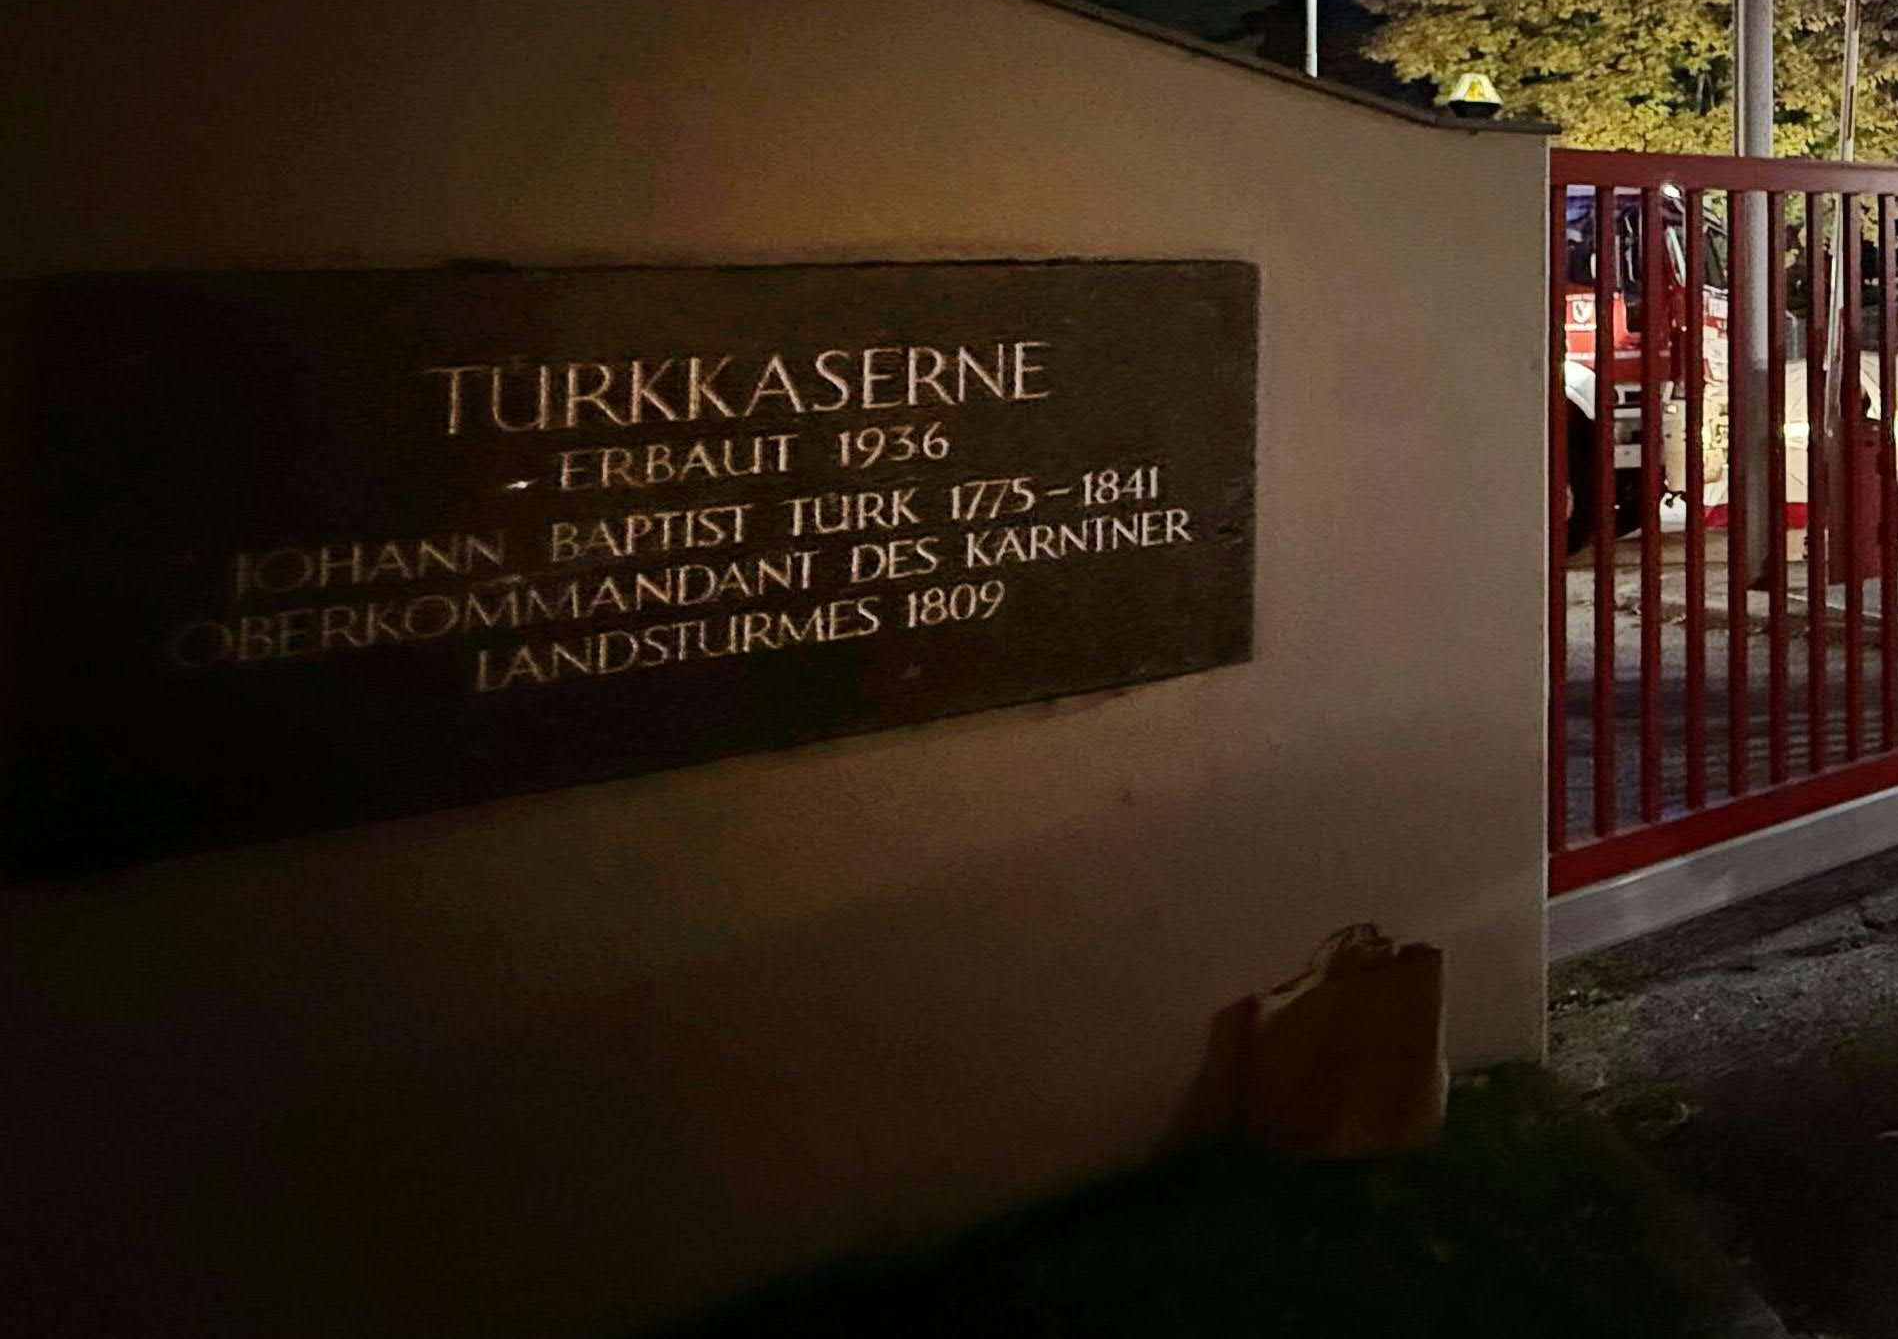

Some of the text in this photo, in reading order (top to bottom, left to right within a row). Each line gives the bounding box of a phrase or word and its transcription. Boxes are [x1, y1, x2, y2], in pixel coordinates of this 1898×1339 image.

[558, 421, 951, 492] ERBAUT 1936
[166, 550, 819, 665] OBERKOMMANDANT
[850, 536, 940, 584] DES
[232, 531, 505, 602] JOHANN
[552, 504, 754, 561] BAPTIST
[474, 579, 1006, 693] LANDSTURMES 1809
